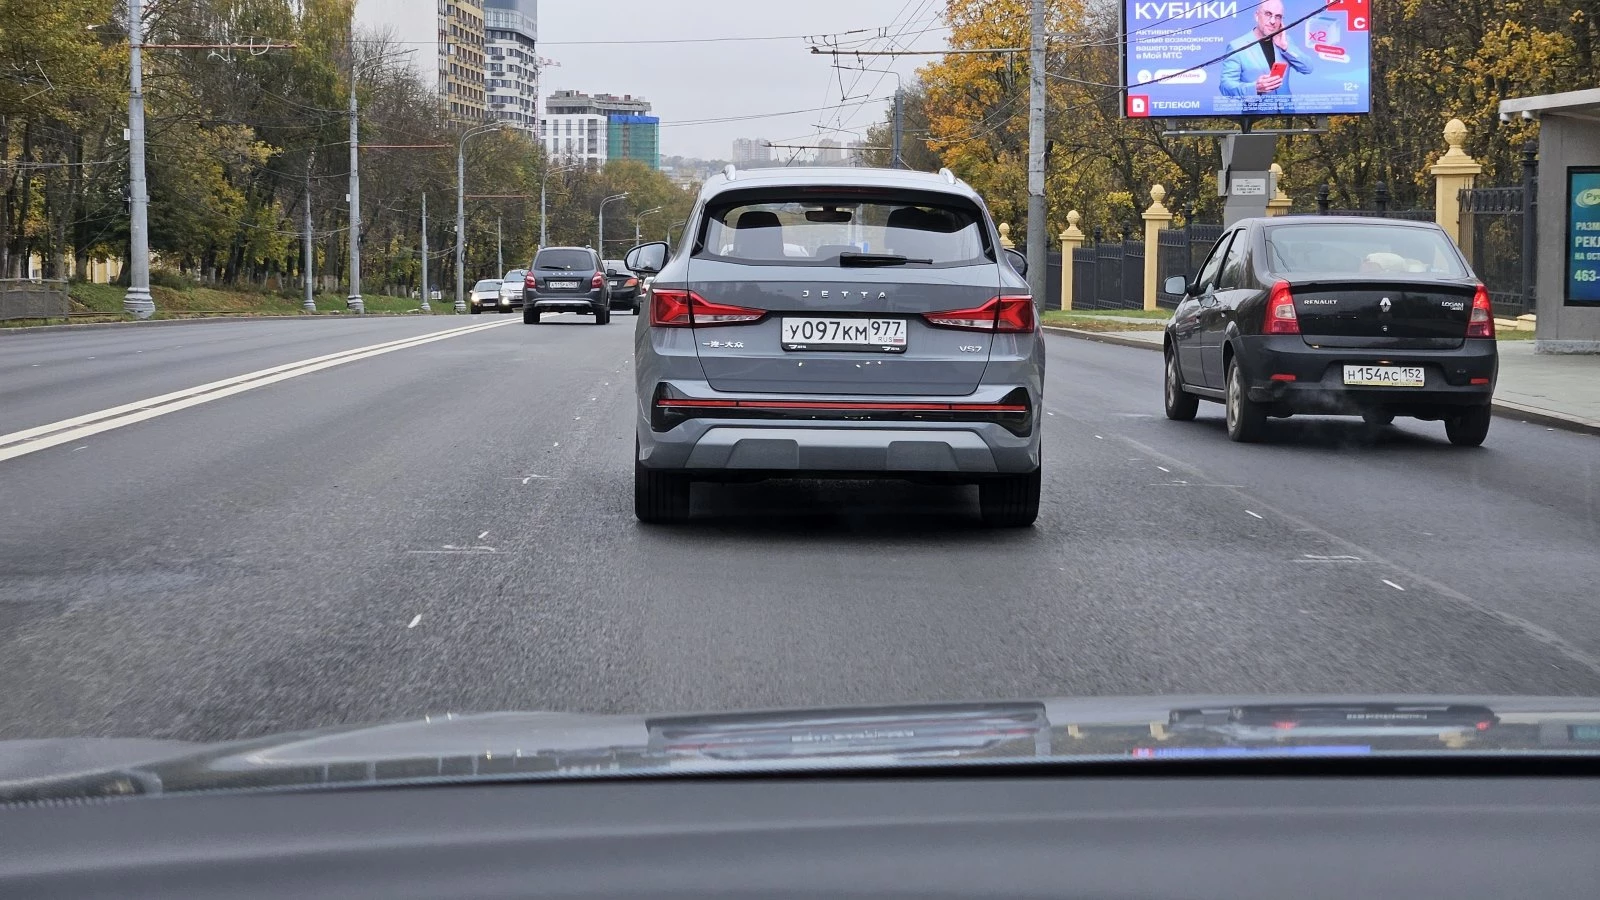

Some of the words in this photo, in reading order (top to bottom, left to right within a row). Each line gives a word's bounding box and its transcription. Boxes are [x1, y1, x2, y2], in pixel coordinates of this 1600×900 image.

[1135, 1, 1237, 20] КУБИКИ
[1169, 44, 1202, 52] тарифа
[1143, 51, 1162, 59] Мой
[1163, 51, 1183, 59] МТС
[1343, 82, 1360, 91] 12+
[1152, 100, 1200, 109] ТЕЛЕКОМ
[802, 290, 887, 299] JETTA
[871, 320, 901, 336] 977
[959, 345, 982, 353] VS7
[1401, 368, 1421, 379] 152
